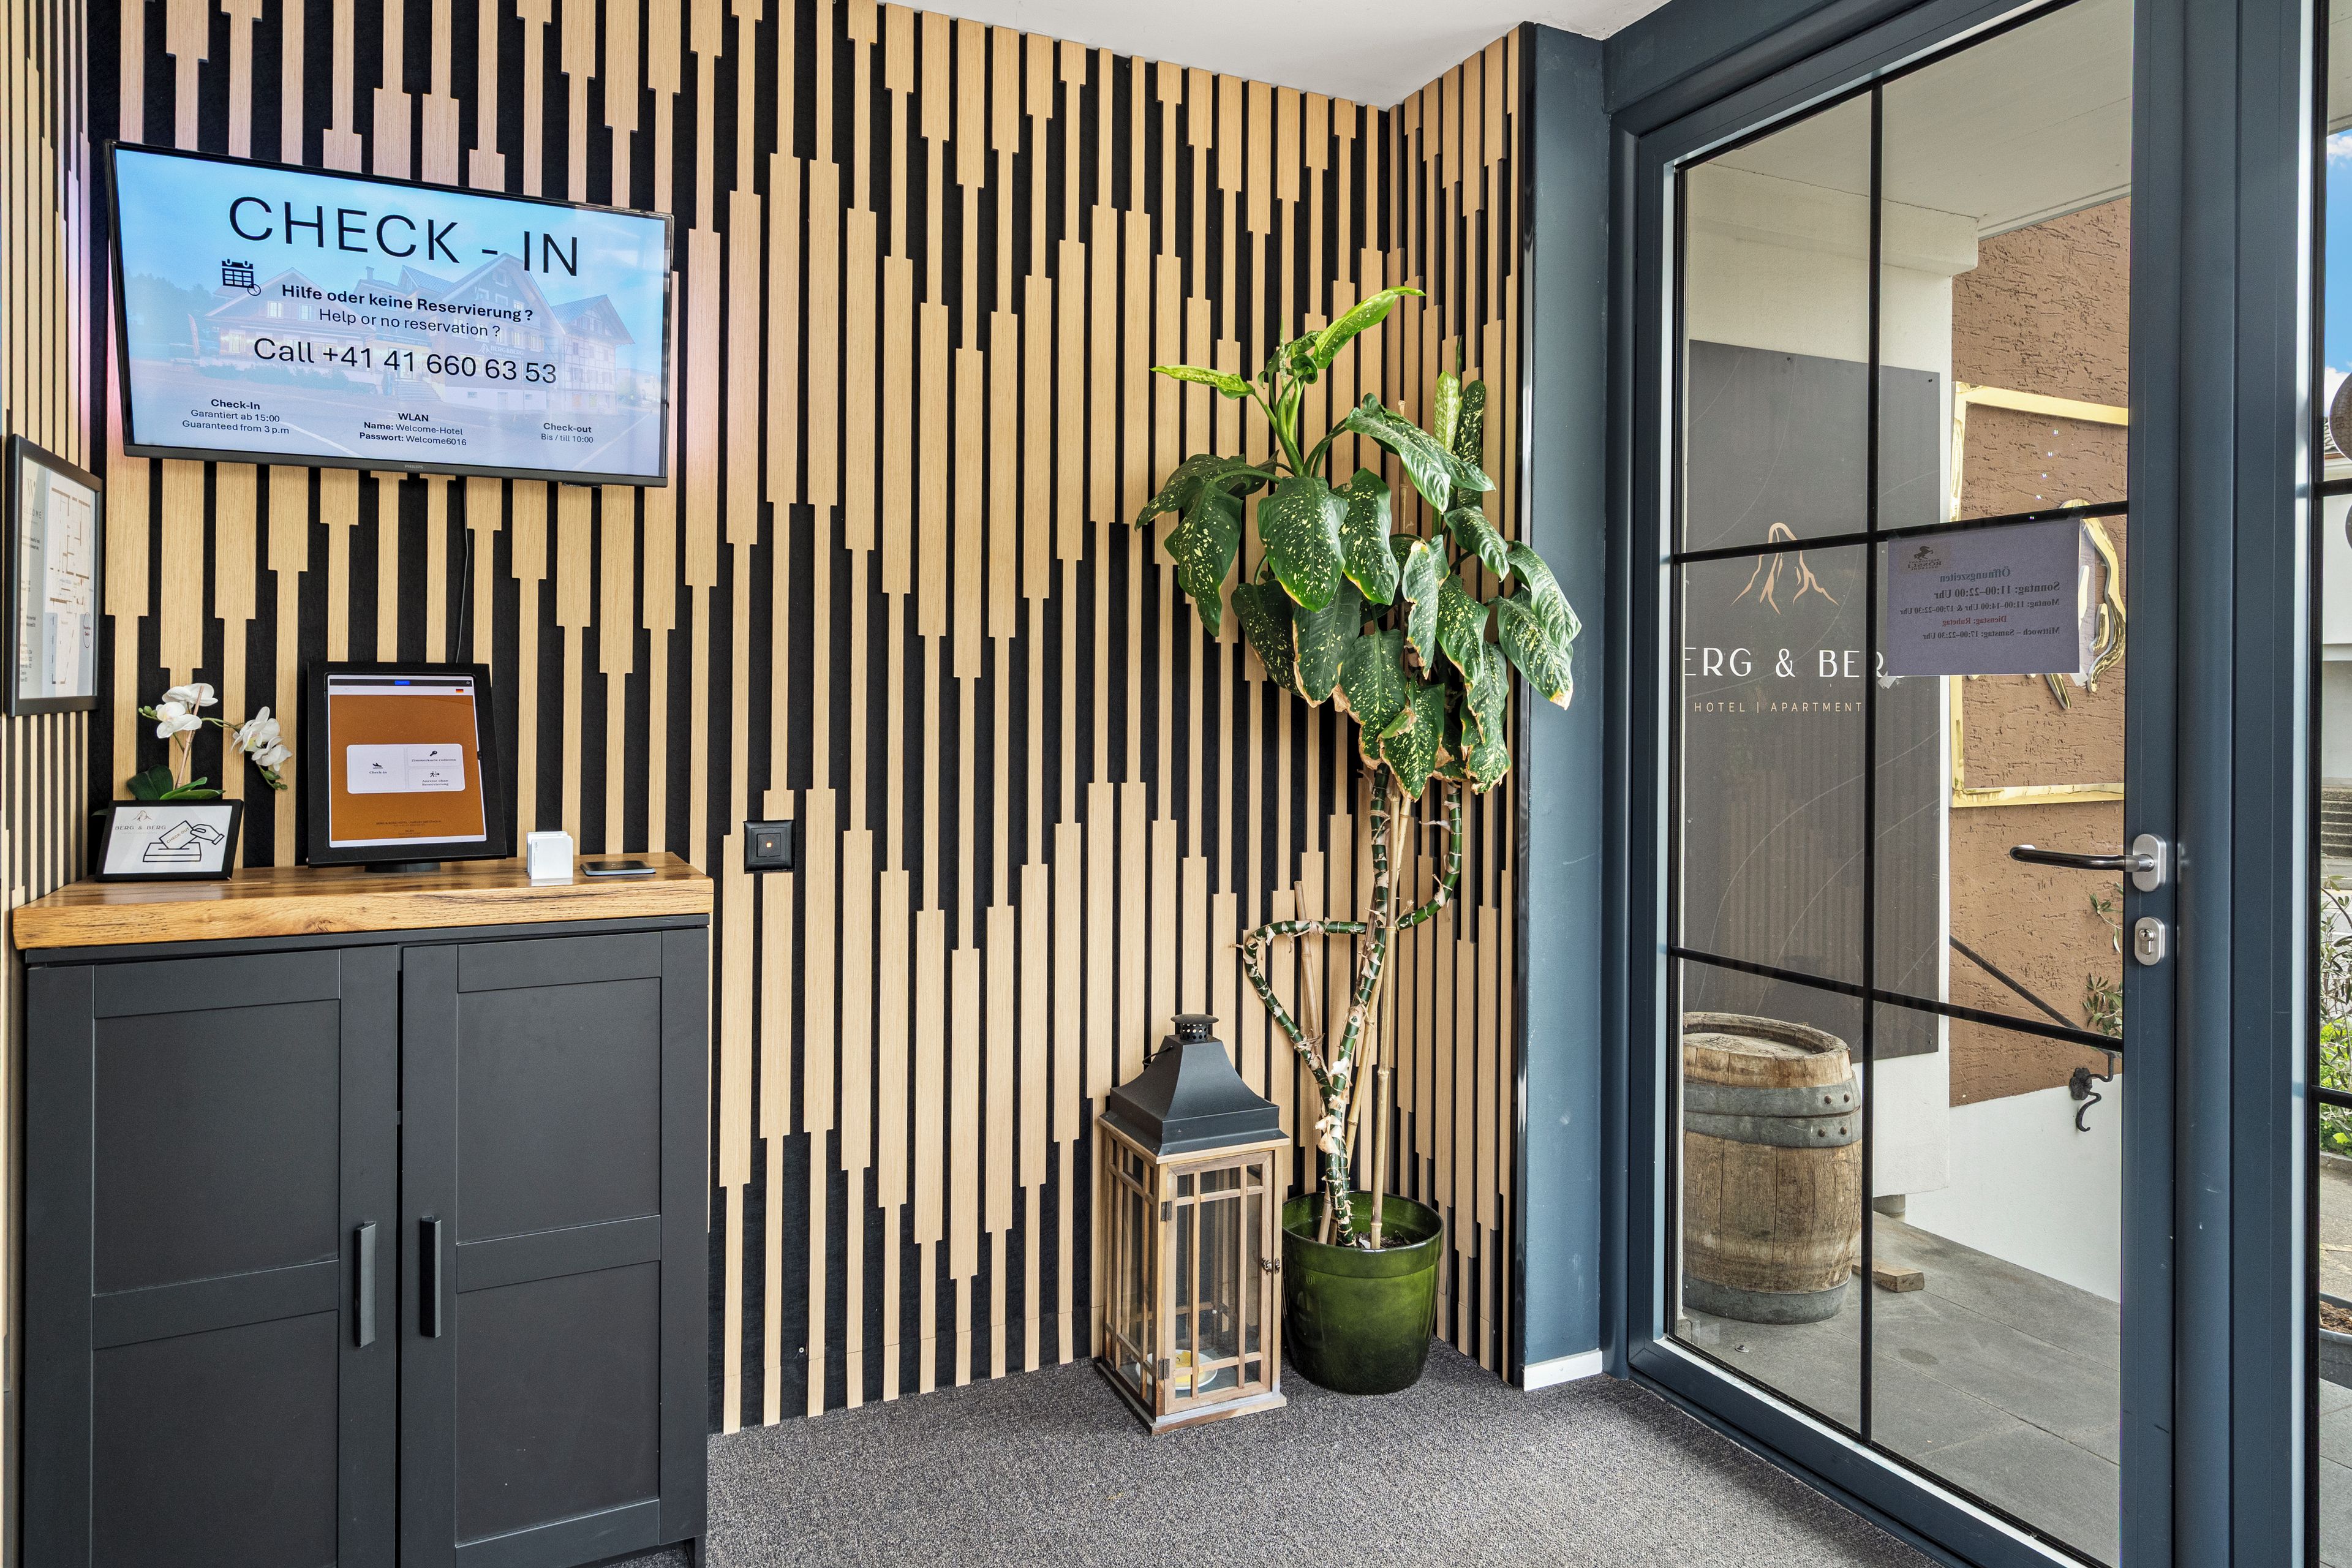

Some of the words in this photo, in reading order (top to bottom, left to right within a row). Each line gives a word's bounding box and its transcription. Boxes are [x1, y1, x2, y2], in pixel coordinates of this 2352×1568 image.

[229, 196, 460, 263] CHECK
[524, 231, 578, 277] IN
[282, 284, 322, 300] Hilfe
[327, 290, 364, 304] oder
[369, 293, 413, 309] keine
[417, 298, 521, 322] Reservierung
[525, 309, 533, 321] ?
[319, 309, 356, 326] Help
[361, 314, 377, 325] or
[381, 317, 400, 328] no
[404, 318, 488, 336] reservation
[492, 325, 500, 337] ?
[254, 337, 314, 364] Call
[323, 347, 371, 369] +41
[384, 351, 413, 372] 41
[427, 354, 477, 377] 660
[485, 359, 517, 381] 63
[525, 363, 557, 384] 53
[211, 399, 260, 410] Check-In
[191, 409, 238, 420] Garantiert
[398, 413, 429, 422] WLAN
[182, 420, 238, 431] Guaranteed
[240, 424, 262, 432] from
[364, 421, 394, 430] Name:
[396, 424, 463, 435] Welcome-Hotel
[543, 423, 592, 433] Check-out
[360, 432, 404, 442] Passwort:
[405, 435, 467, 445] Welcome6016
[1684, 647, 1752, 677] ERG
[1776, 647, 1796, 678] &
[1819, 649, 1905, 679] BER
[1694, 702, 1746, 712] HOTEL
[166, 827, 190, 844] CHECK-OUT
